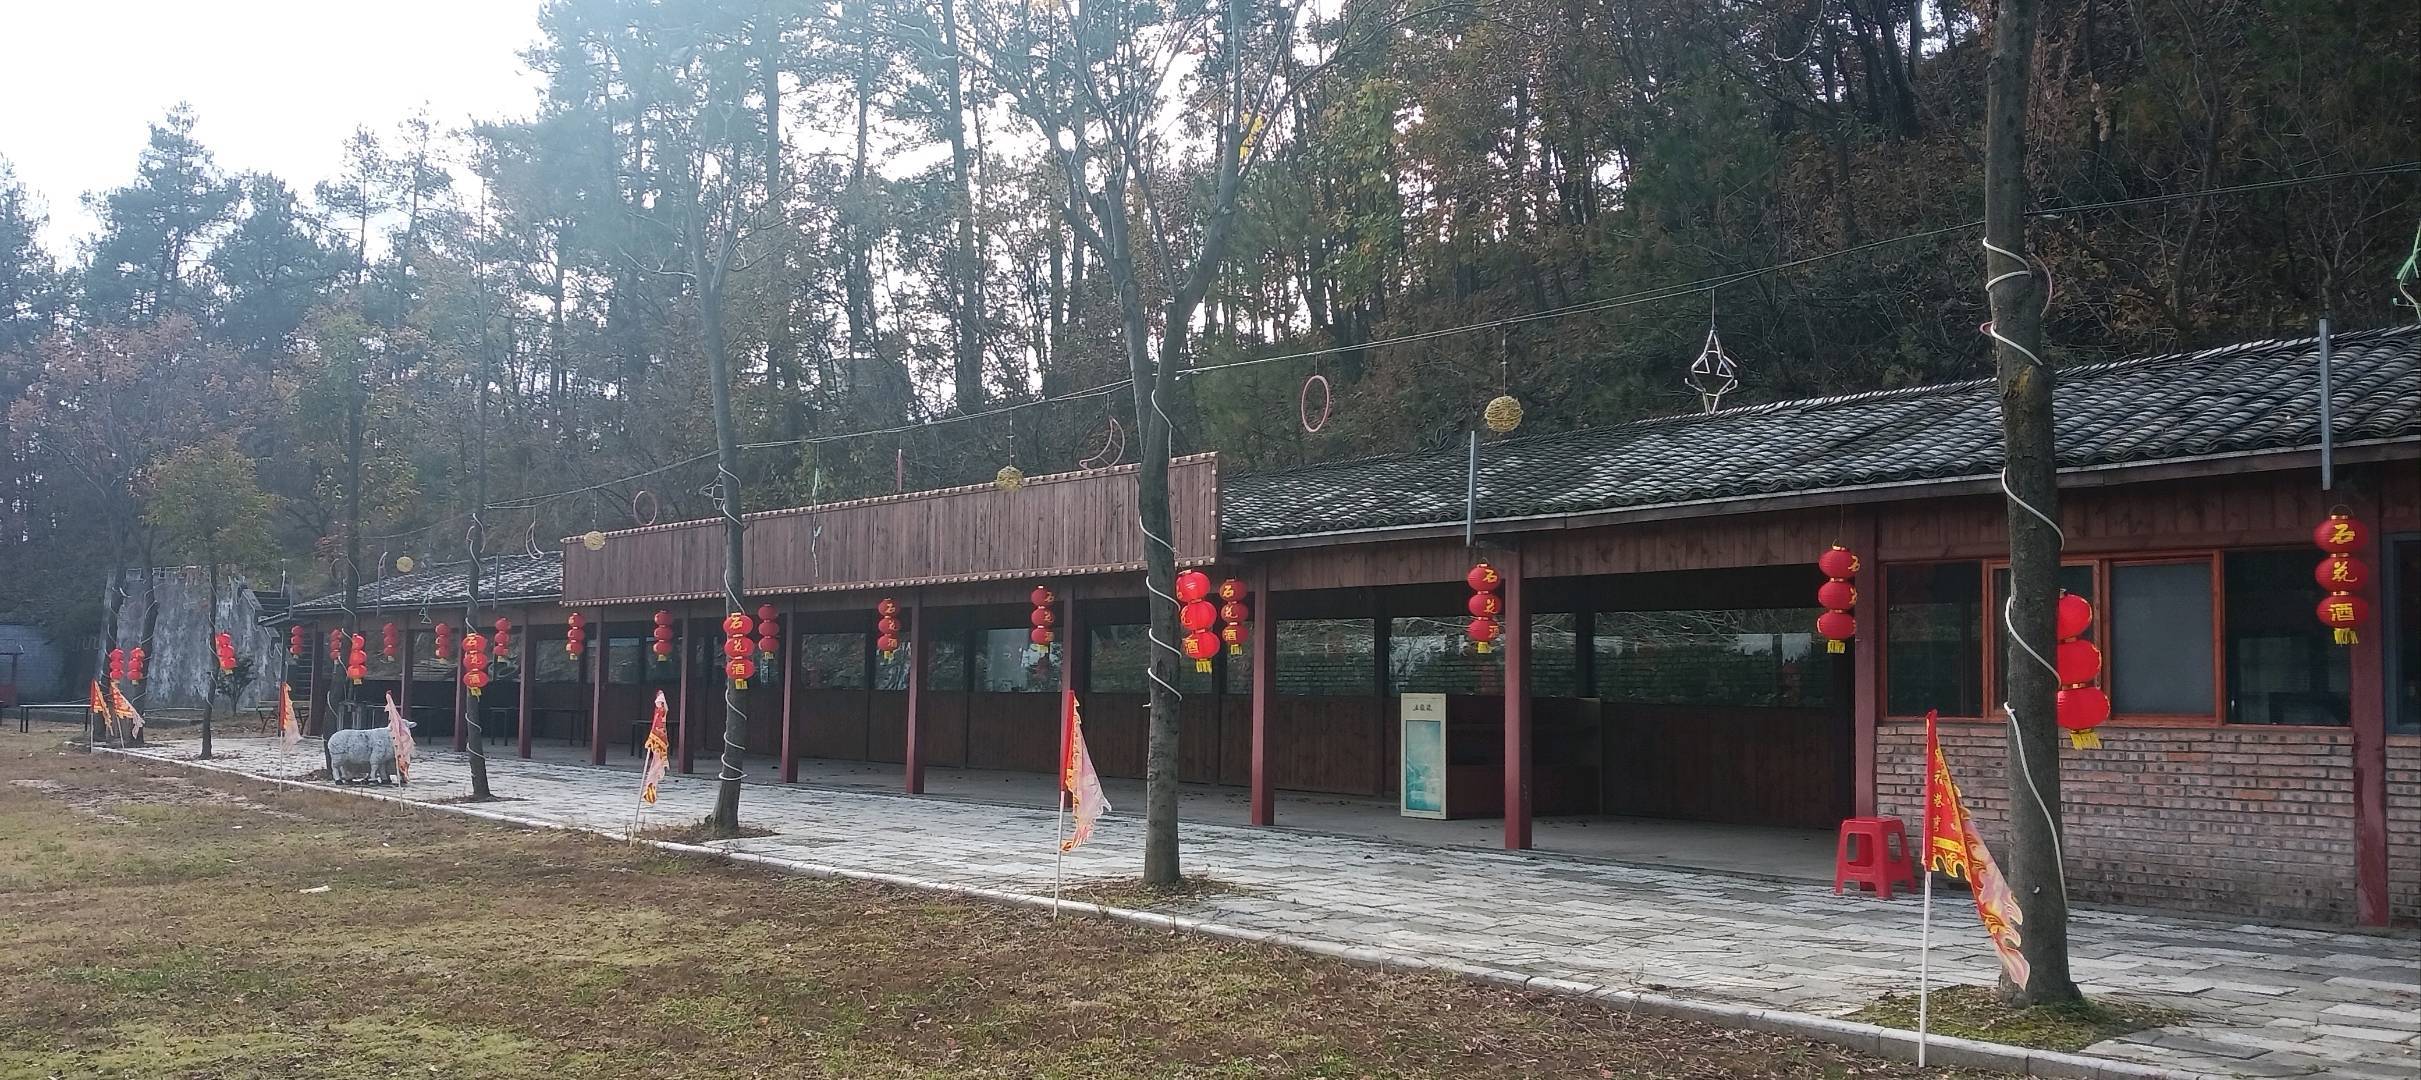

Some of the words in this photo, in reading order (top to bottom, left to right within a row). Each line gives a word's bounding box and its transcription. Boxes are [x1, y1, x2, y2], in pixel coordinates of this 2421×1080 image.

[1482, 569, 1500, 639] 石花酒
[2329, 523, 2358, 622] 石花酒
[730, 614, 747, 676] 石花酒
[1223, 584, 1239, 641] 石花酒
